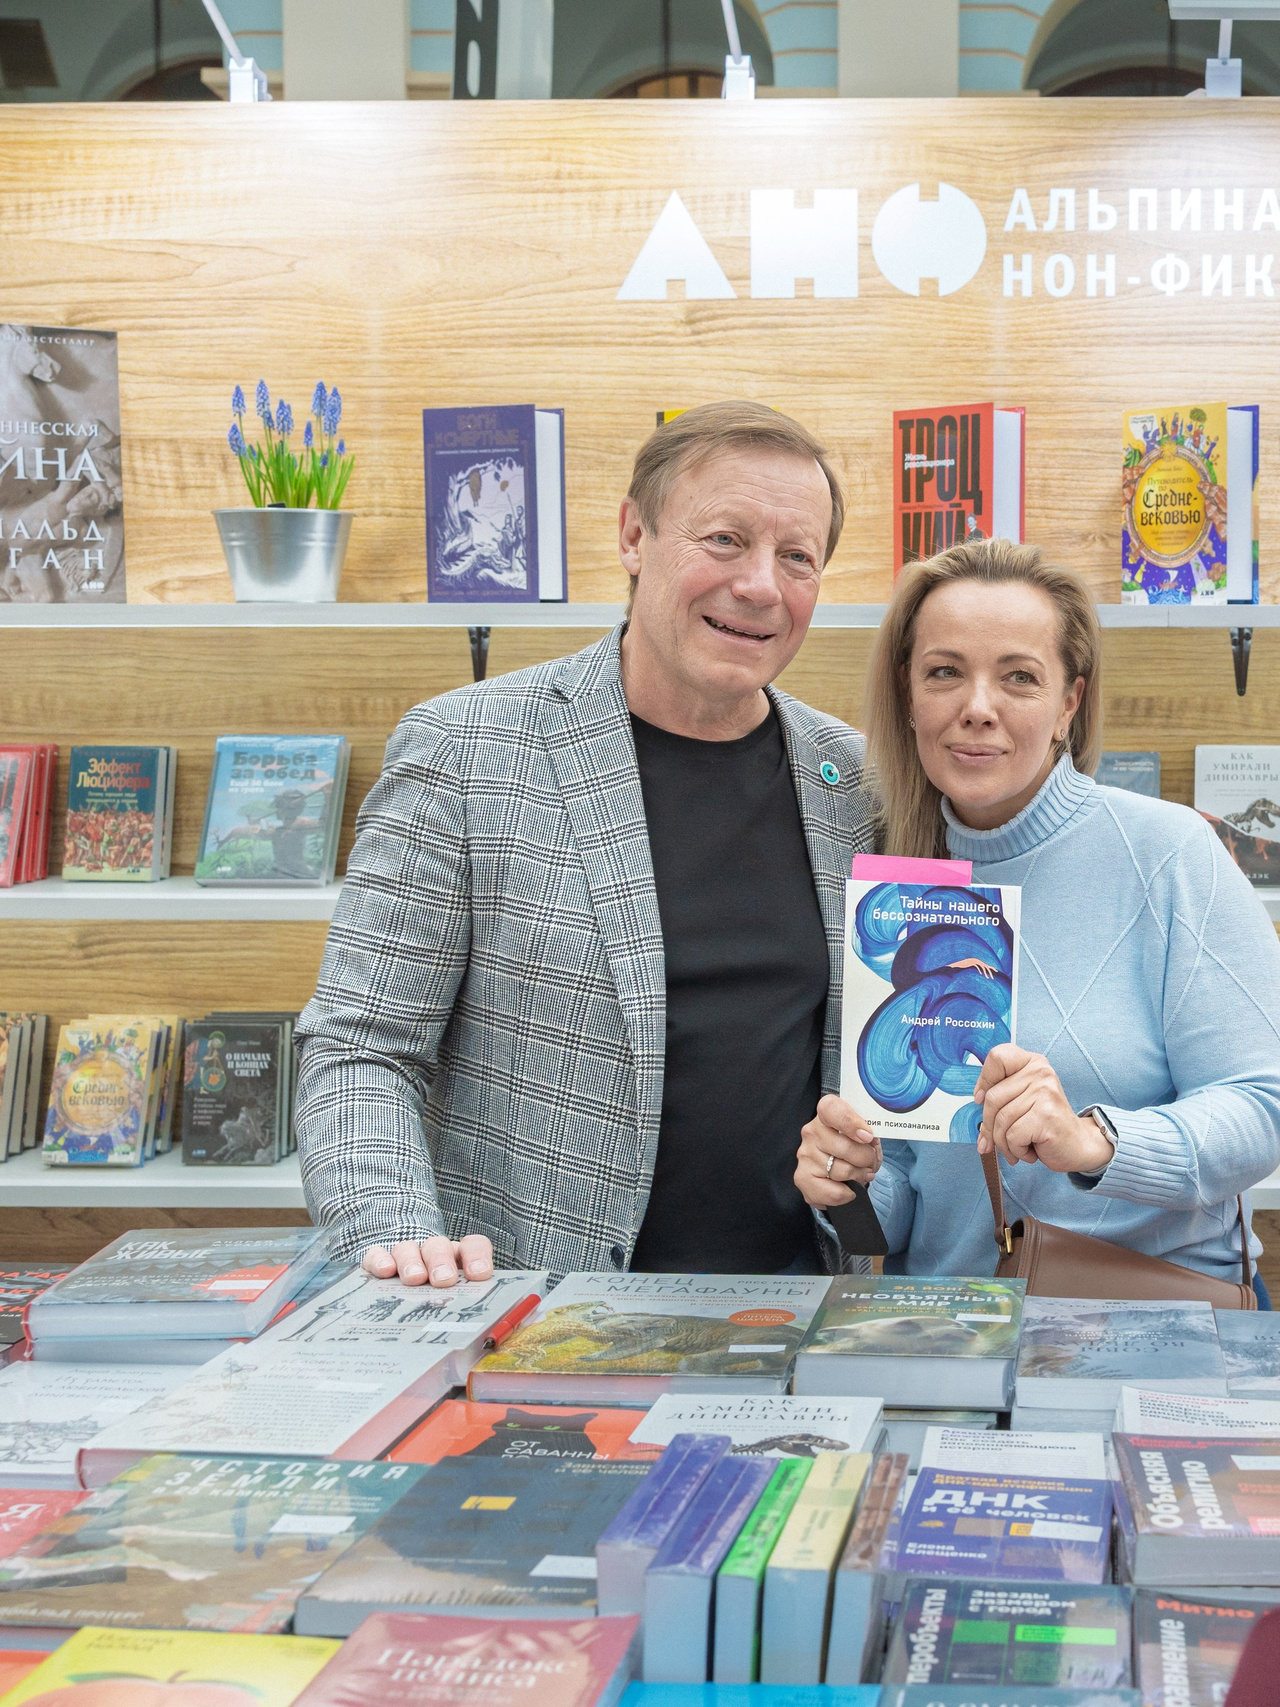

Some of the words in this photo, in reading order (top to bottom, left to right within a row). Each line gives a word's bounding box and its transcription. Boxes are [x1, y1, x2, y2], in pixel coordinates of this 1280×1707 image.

[899, 412, 983, 516] ТРОЦ
[1142, 488, 1198, 511] Средне-
[1140, 509, 1201, 527] вековью
[232, 750, 318, 768] Борьба
[1230, 752, 1254, 761] КАК
[87, 757, 142, 778] Эффект
[231, 768, 255, 779] за
[264, 766, 316, 781] обед
[1213, 763, 1271, 772] УМИРАЛИ
[76, 771, 151, 792] Люцифера
[1203, 773, 1279, 782] ДИНОЗАВРЫ
[899, 895, 943, 911] Тайны
[948, 899, 1001, 914] нашего
[873, 908, 1001, 927] бессознательного
[901, 1013, 942, 1028] Андрей
[945, 1017, 996, 1030] Россохин
[233, 1052, 272, 1061] НАЧАЛАХ
[234, 1069, 262, 1077] СВЕТА
[884, 1120, 941, 1132] психоанализа
[120, 1240, 177, 1250] КАК
[106, 1249, 216, 1261] ЖИВЫЕ
[587, 1276, 695, 1287] КОНЕЦ
[606, 1285, 812, 1297] МЕГАФАУНЫ
[841, 1292, 1011, 1303] НЕОБЪЯТНЫЙ
[695, 1405, 833, 1414] УМИРАЛИ
[666, 1413, 850, 1422] ДИНОЗАВРЫ
[510, 1440, 541, 1449] ОТ
[503, 1447, 610, 1460] САВАННЫ
[164, 1471, 340, 1492] ЗЕМЛИ
[932, 1479, 1094, 1494] ДНК-идентификации
[934, 1473, 998, 1483] Краткая
[1003, 1478, 1066, 1488] история
[921, 1489, 1052, 1511] ДНК
[1180, 1459, 1235, 1531] религию
[985, 1508, 1092, 1523] человек
[906, 1541, 956, 1551] Елена
[905, 1548, 989, 1560] Клещенко
[971, 1589, 1051, 1601] Звезды
[969, 1597, 1078, 1609] размером
[1156, 1598, 1255, 1620] Митио
[988, 1606, 1052, 1616] город
